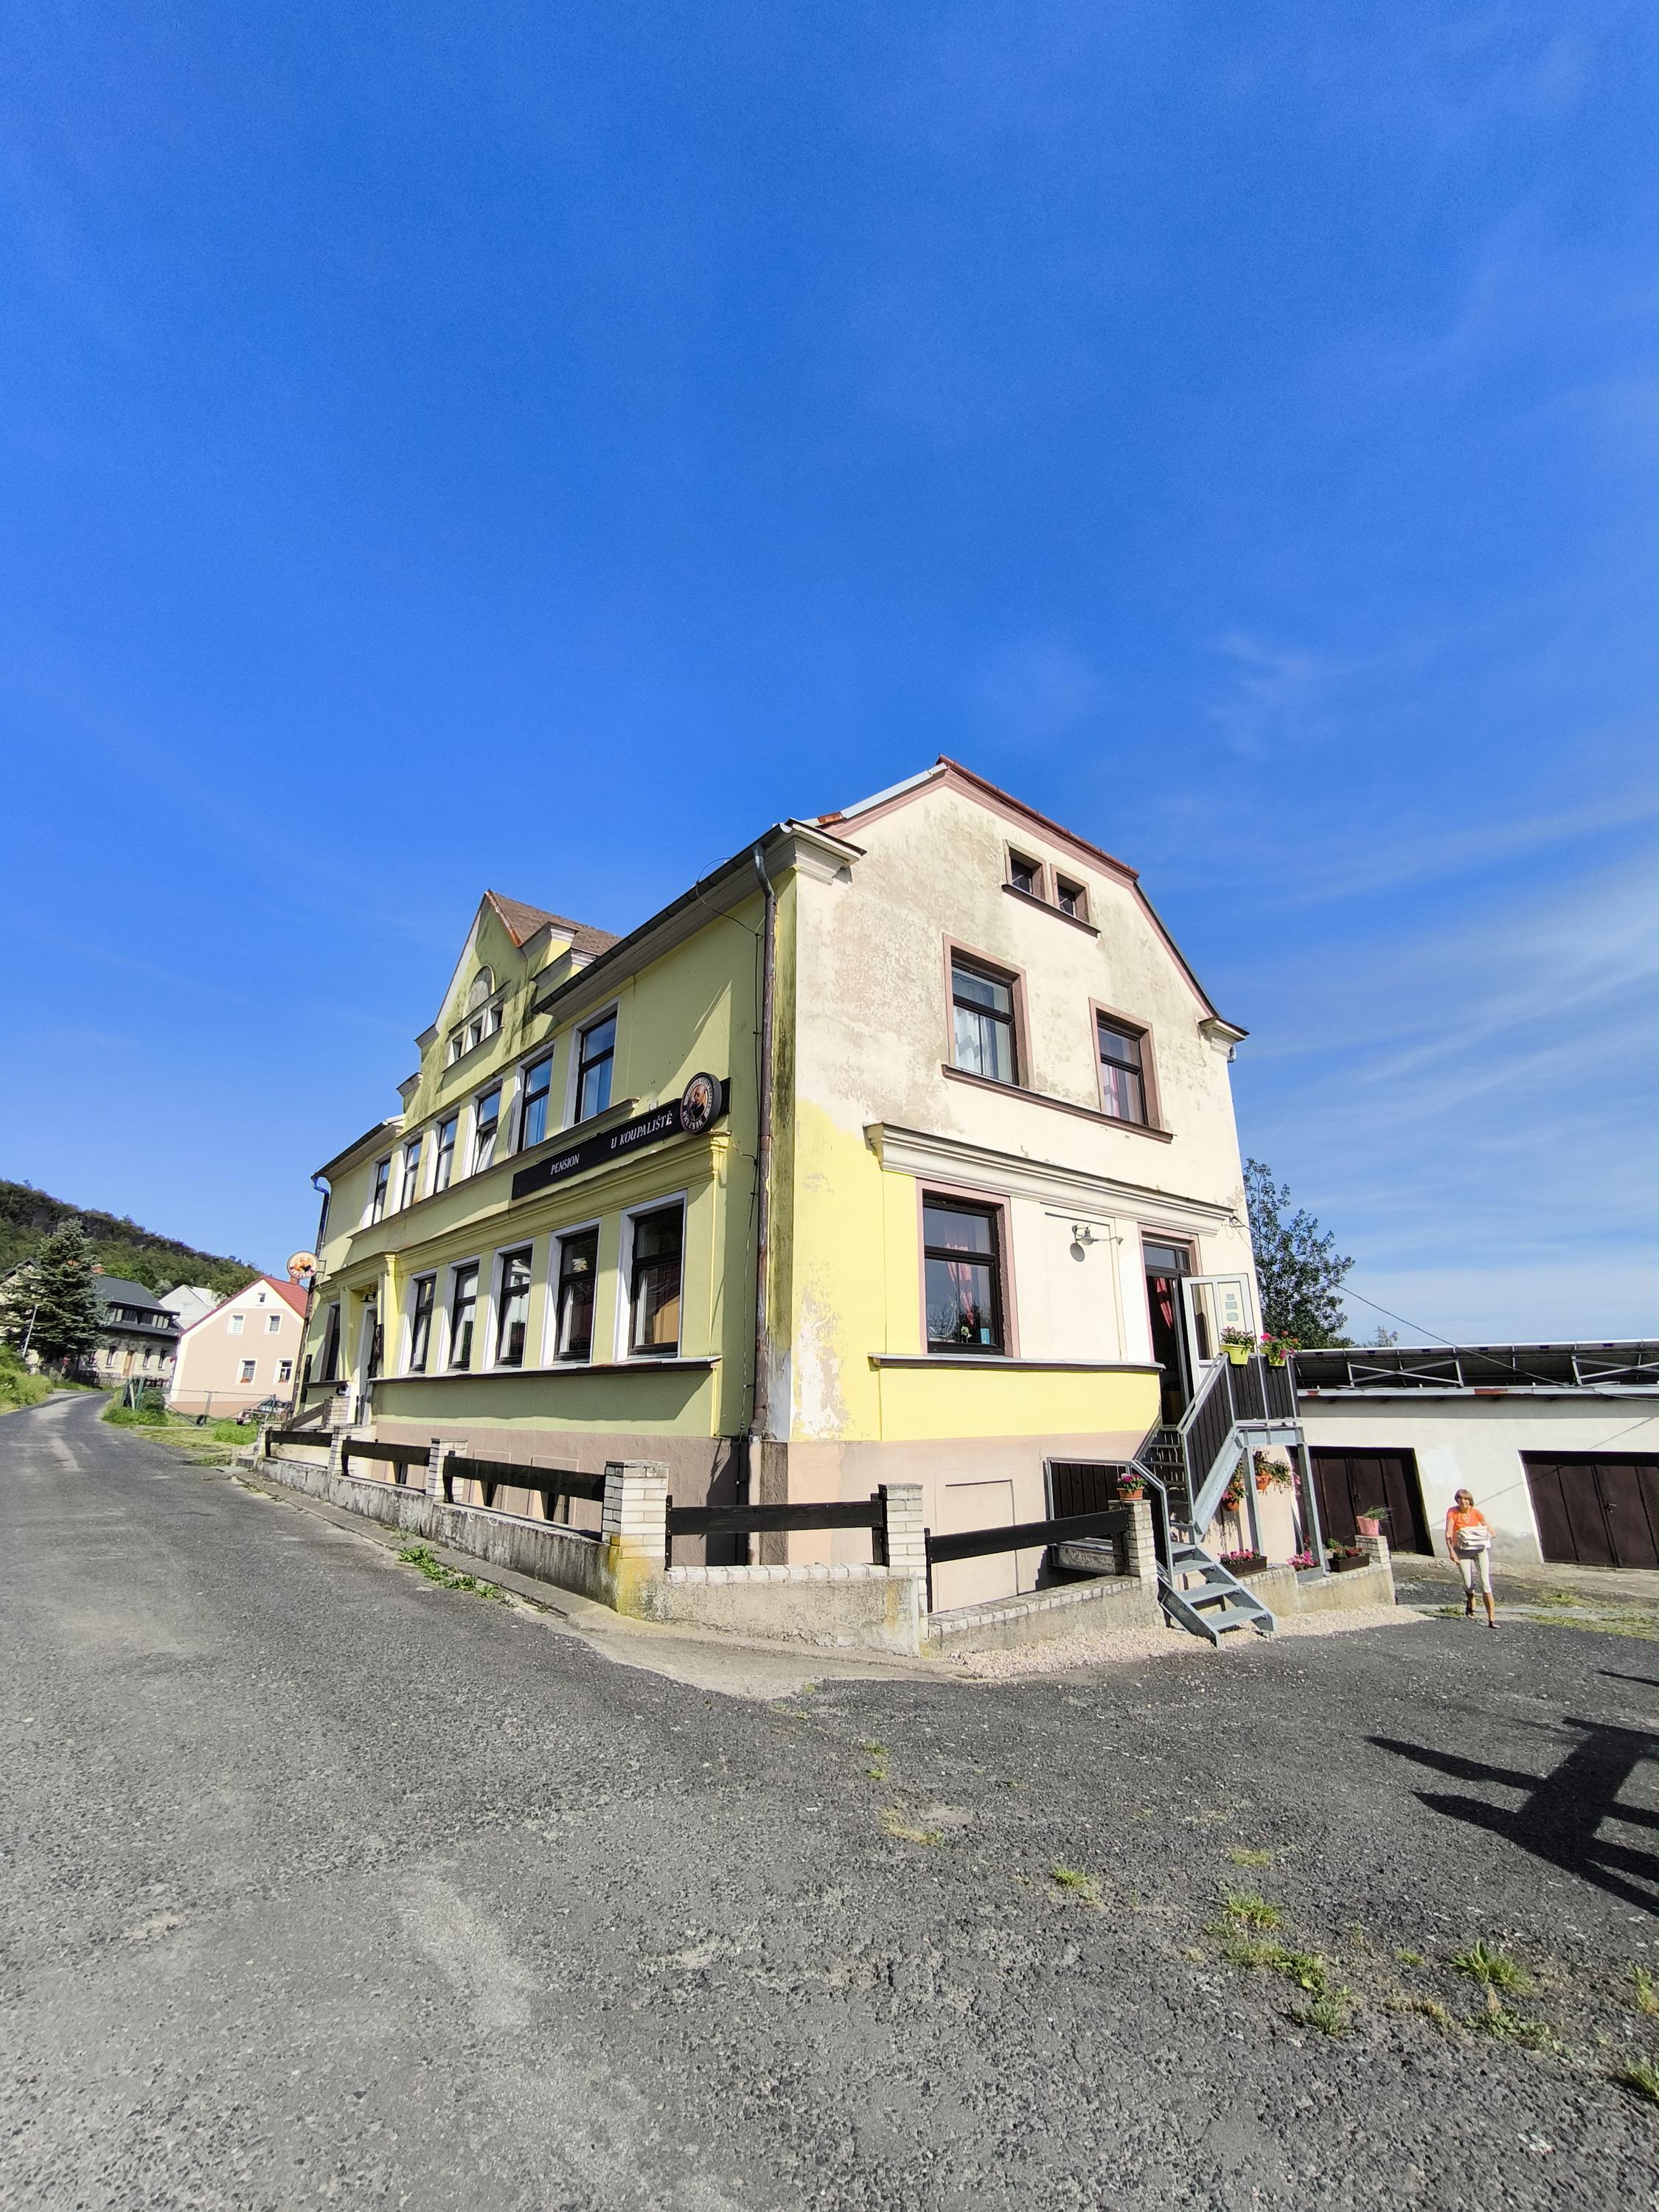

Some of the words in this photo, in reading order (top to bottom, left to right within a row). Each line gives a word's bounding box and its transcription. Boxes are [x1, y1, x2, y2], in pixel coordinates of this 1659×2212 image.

[550, 1153, 580, 1175] PENSION
[611, 1136, 618, 1149] U
[619, 1110, 672, 1145] KOUPALIŠTĚ
